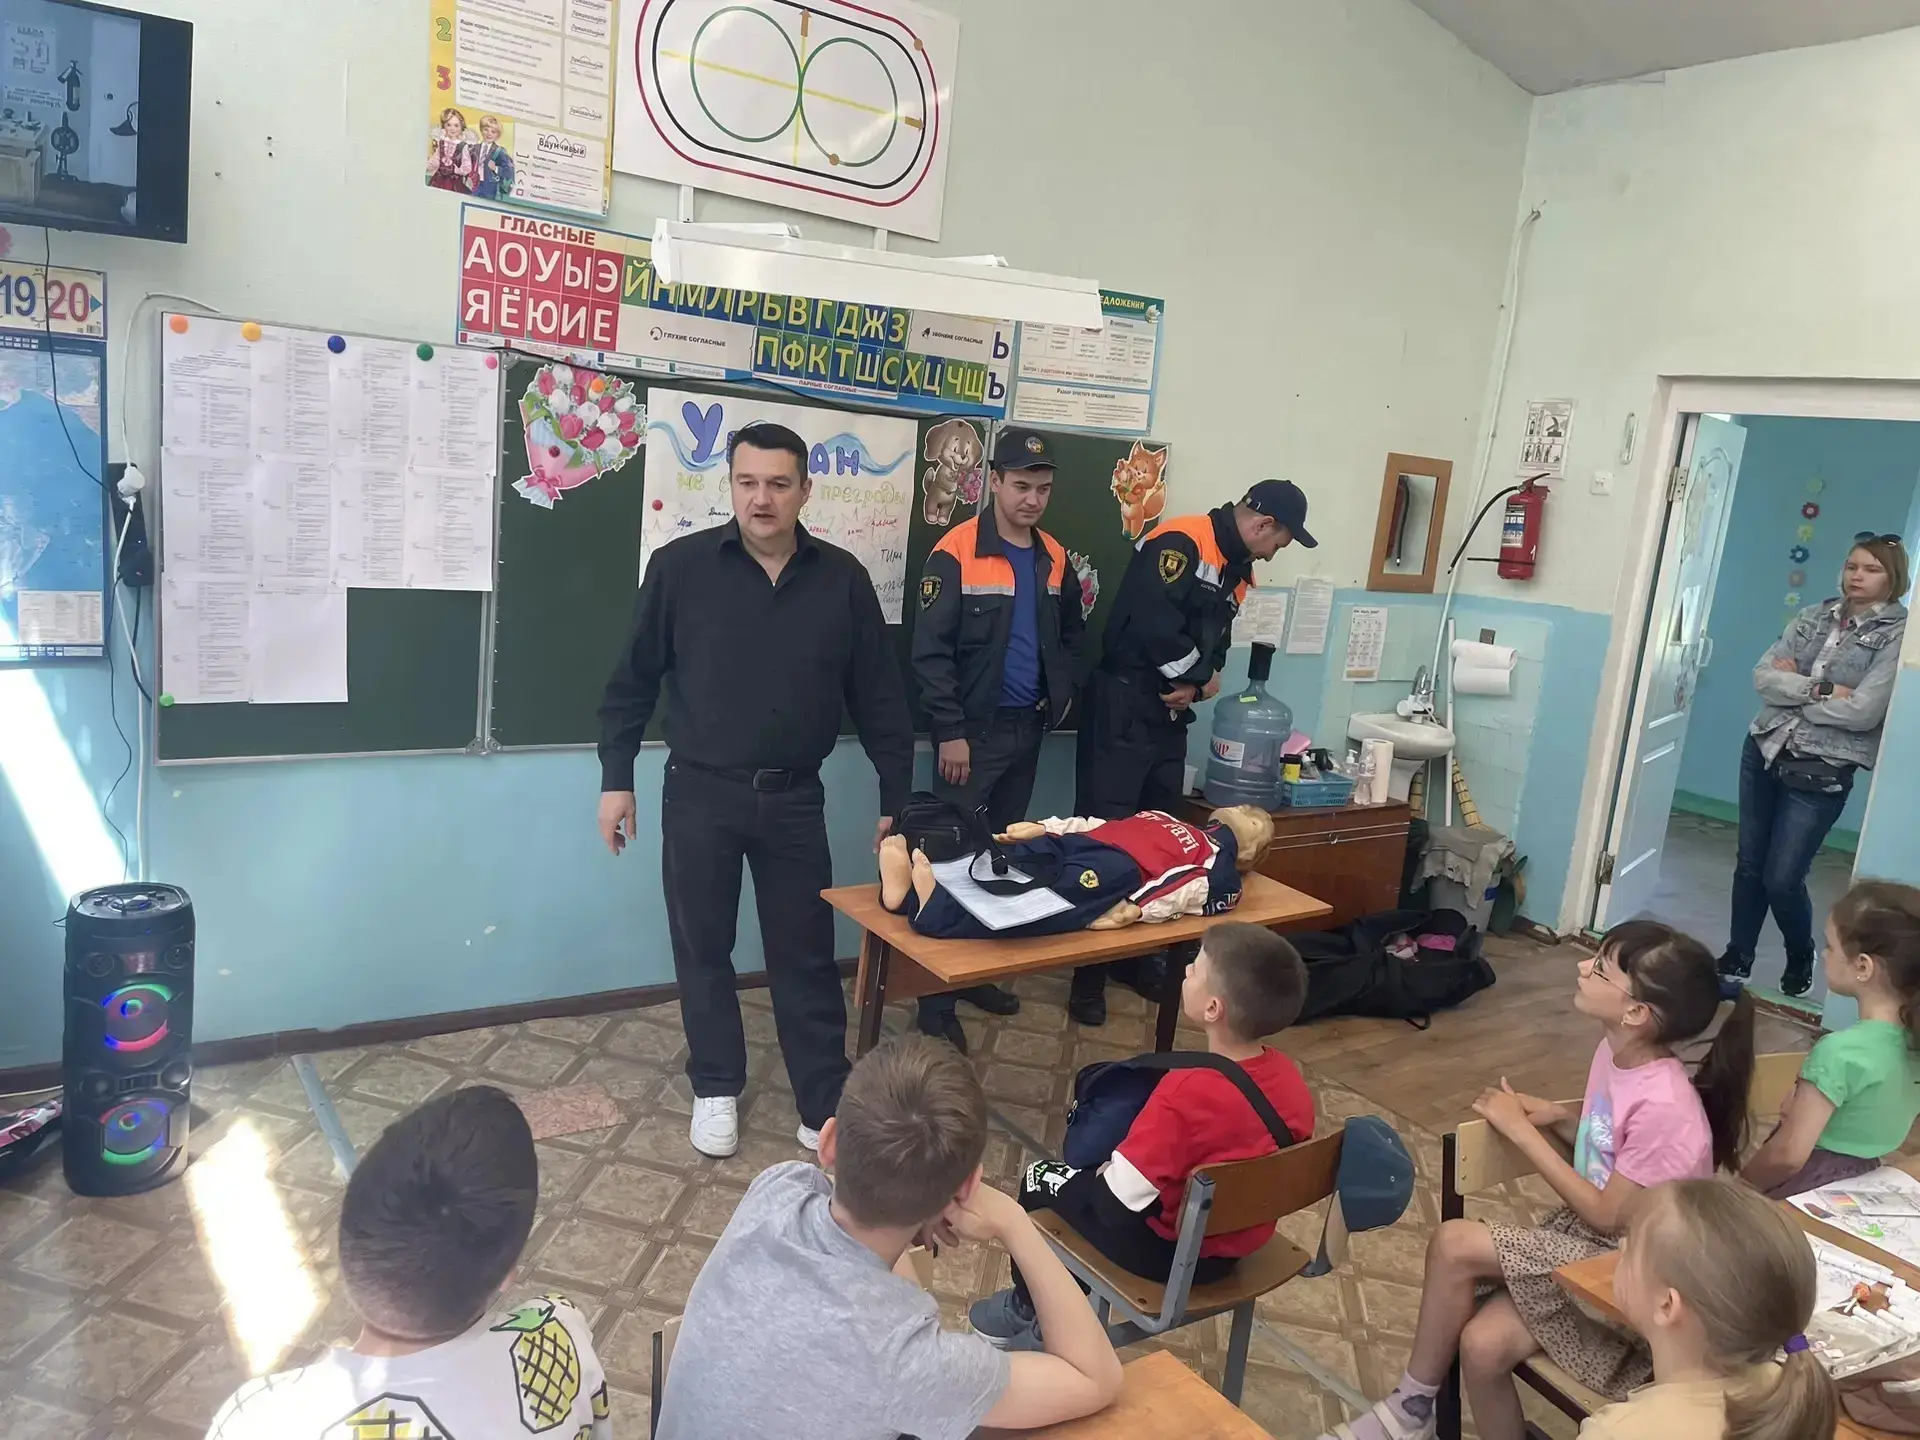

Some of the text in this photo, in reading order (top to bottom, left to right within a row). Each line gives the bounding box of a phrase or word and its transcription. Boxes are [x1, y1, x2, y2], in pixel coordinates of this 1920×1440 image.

[435, 17, 452, 42] 2
[436, 65, 452, 91] 3
[539, 138, 585, 156] Вдумчивый
[500, 215, 596, 246] ГЛАСНЫЕ
[0, 275, 90, 323] 19 20
[664, 332, 726, 347] ГЛУХИЕ СОГЛАСНЫЕ
[954, 333, 984, 345] СОГЛАСНЫЕ
[799, 379, 858, 394] ПАРНЫЕ СОГЛАСНЫЕ
[1530, 544, 1537, 561] 1
